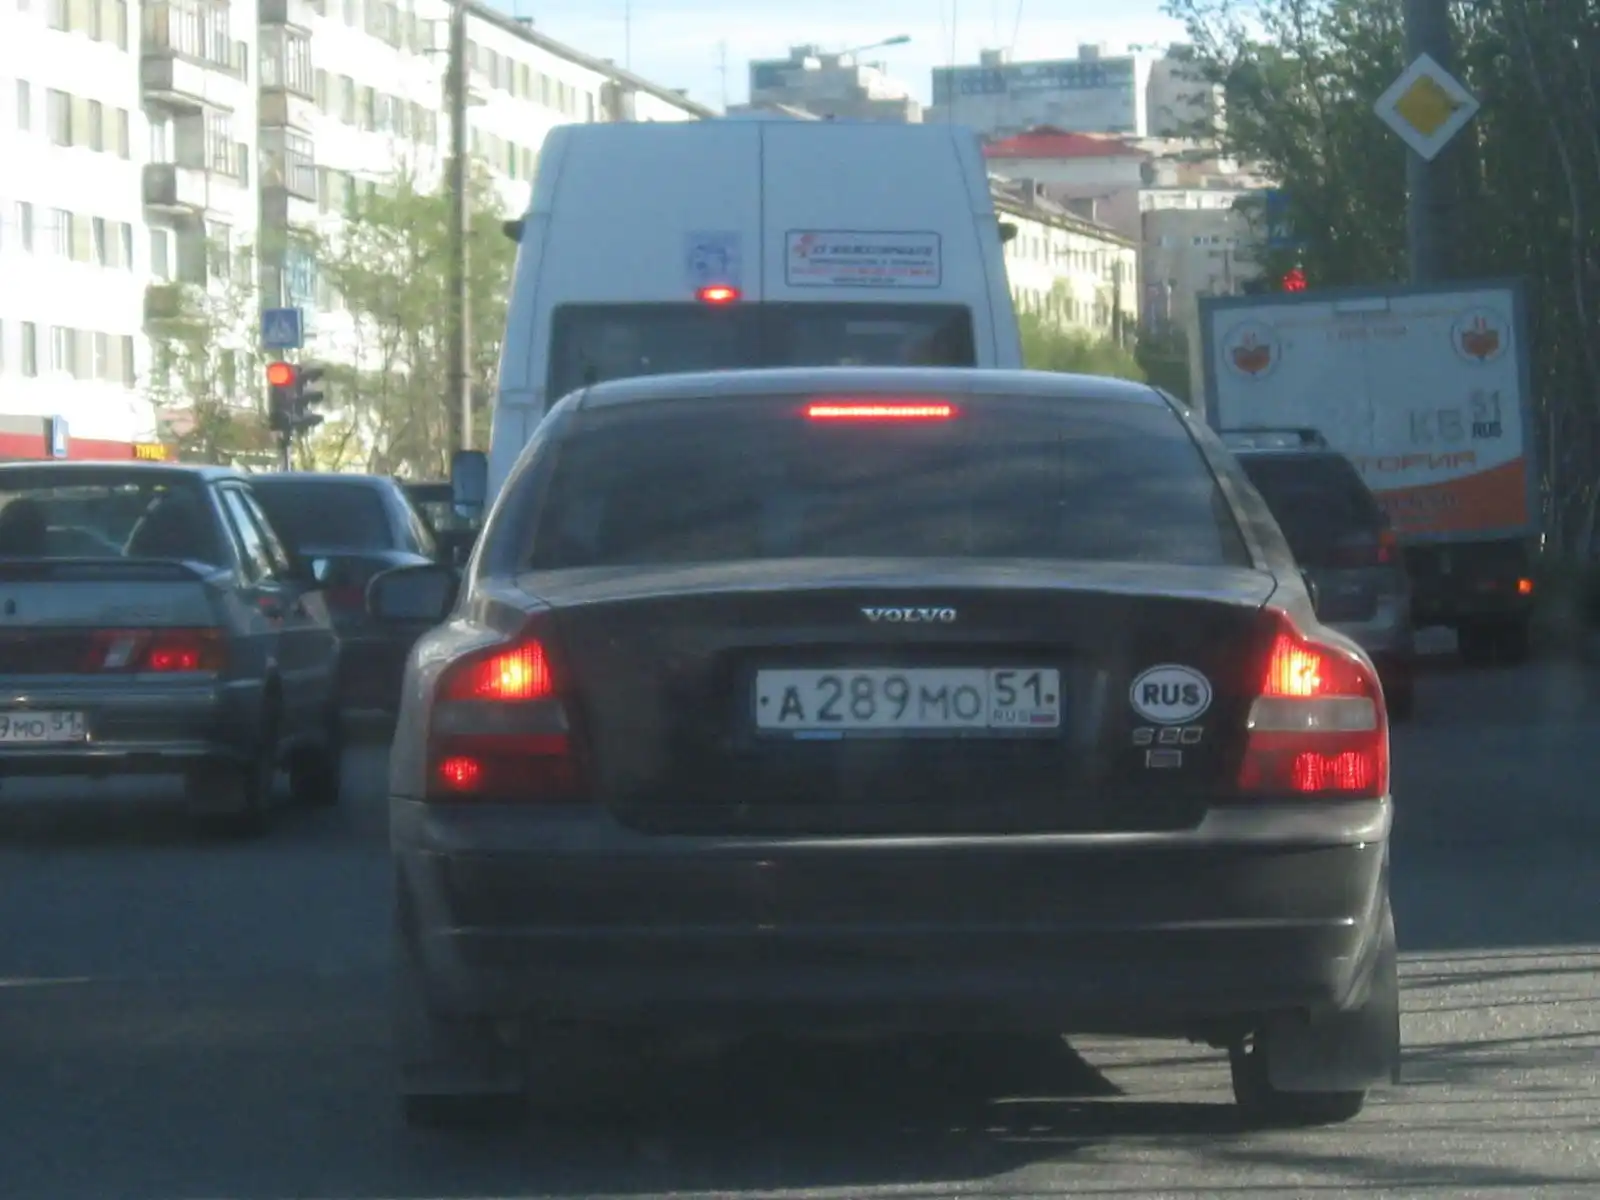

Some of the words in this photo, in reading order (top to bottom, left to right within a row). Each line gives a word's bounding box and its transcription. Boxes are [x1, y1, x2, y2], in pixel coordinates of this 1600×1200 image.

[861, 608, 958, 623] VOLVO
[995, 671, 1041, 707] 51
[1142, 683, 1200, 706] RUS
[994, 709, 1028, 722] RUS
